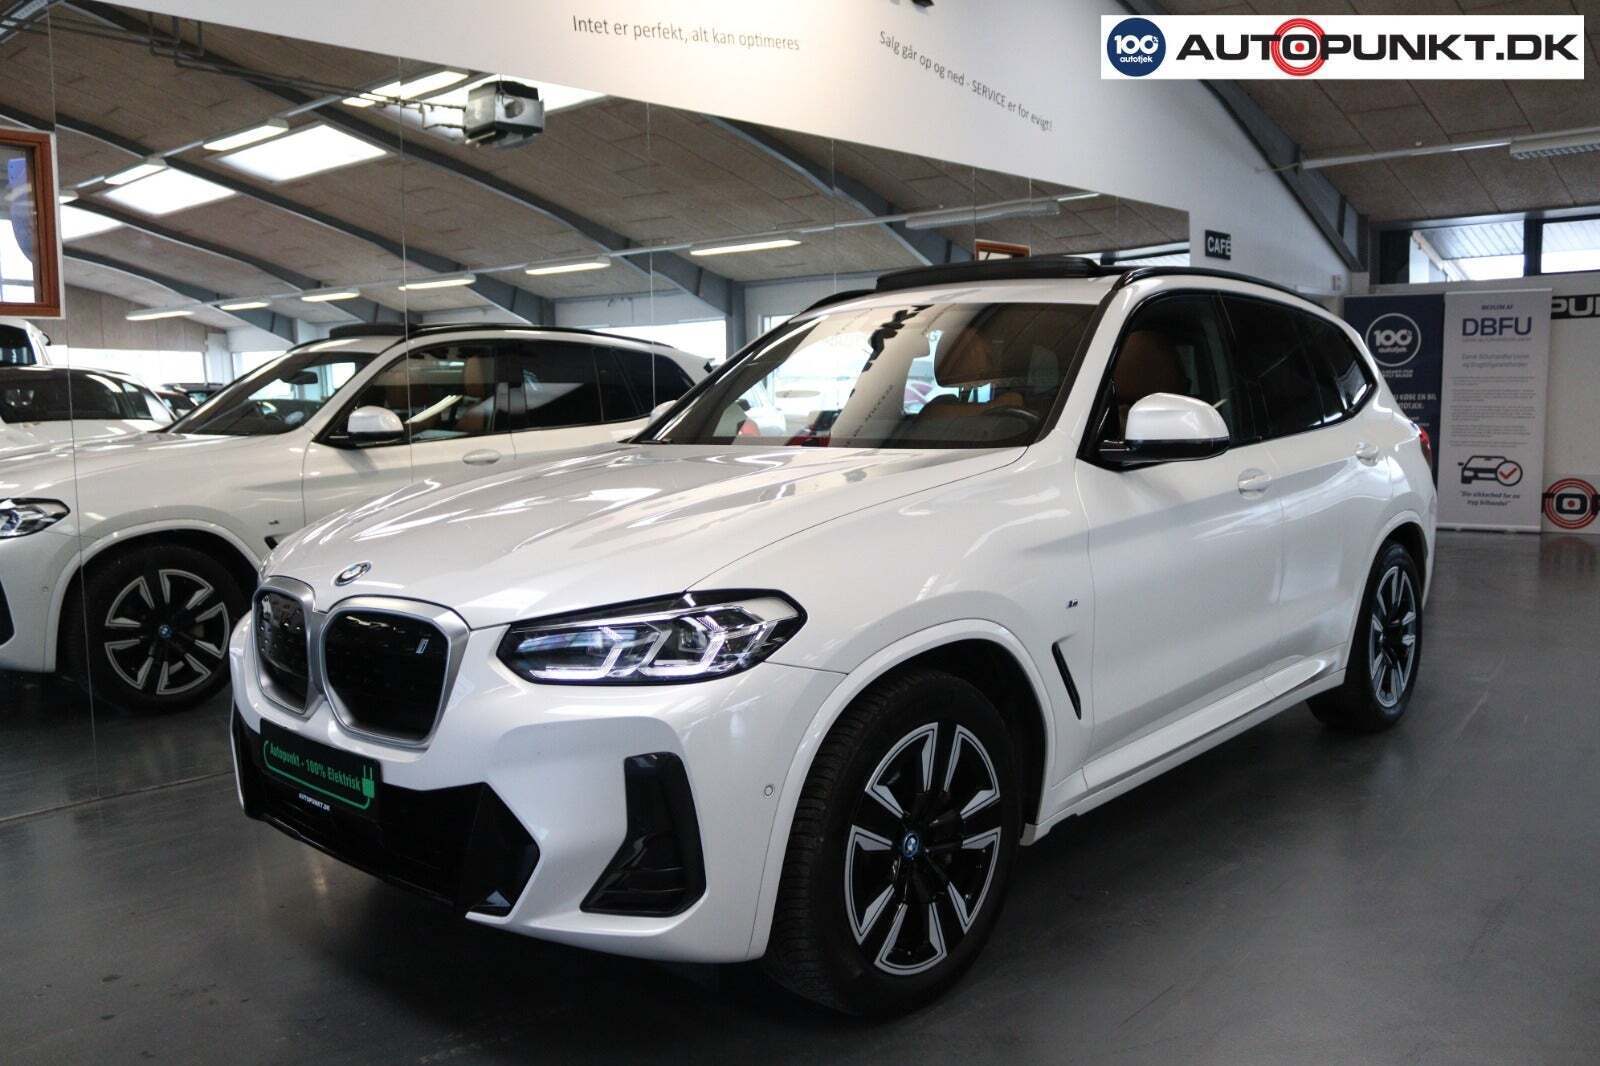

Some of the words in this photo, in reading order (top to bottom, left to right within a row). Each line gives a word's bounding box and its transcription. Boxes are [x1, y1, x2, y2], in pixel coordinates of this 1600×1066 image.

[573, 15, 609, 35] Intet
[613, 22, 628, 36] er
[633, 22, 688, 43] perfekt,
[692, 27, 708, 42] alt
[712, 28, 735, 45] kan
[738, 32, 800, 51] optimeres
[880, 31, 900, 55] Salg
[902, 44, 917, 60] går
[919, 54, 932, 70] op
[934, 62, 945, 79] og
[947, 69, 965, 86] ned
[972, 79, 1006, 108] SERVICE
[1008, 101, 1017, 113] er
[1018, 103, 1029, 119] for
[1462, 316, 1532, 336] DBFU
[270, 742, 300, 767] Autopunkt
[306, 759, 327, 778] 100%
[327, 767, 361, 791] Elektrisk
